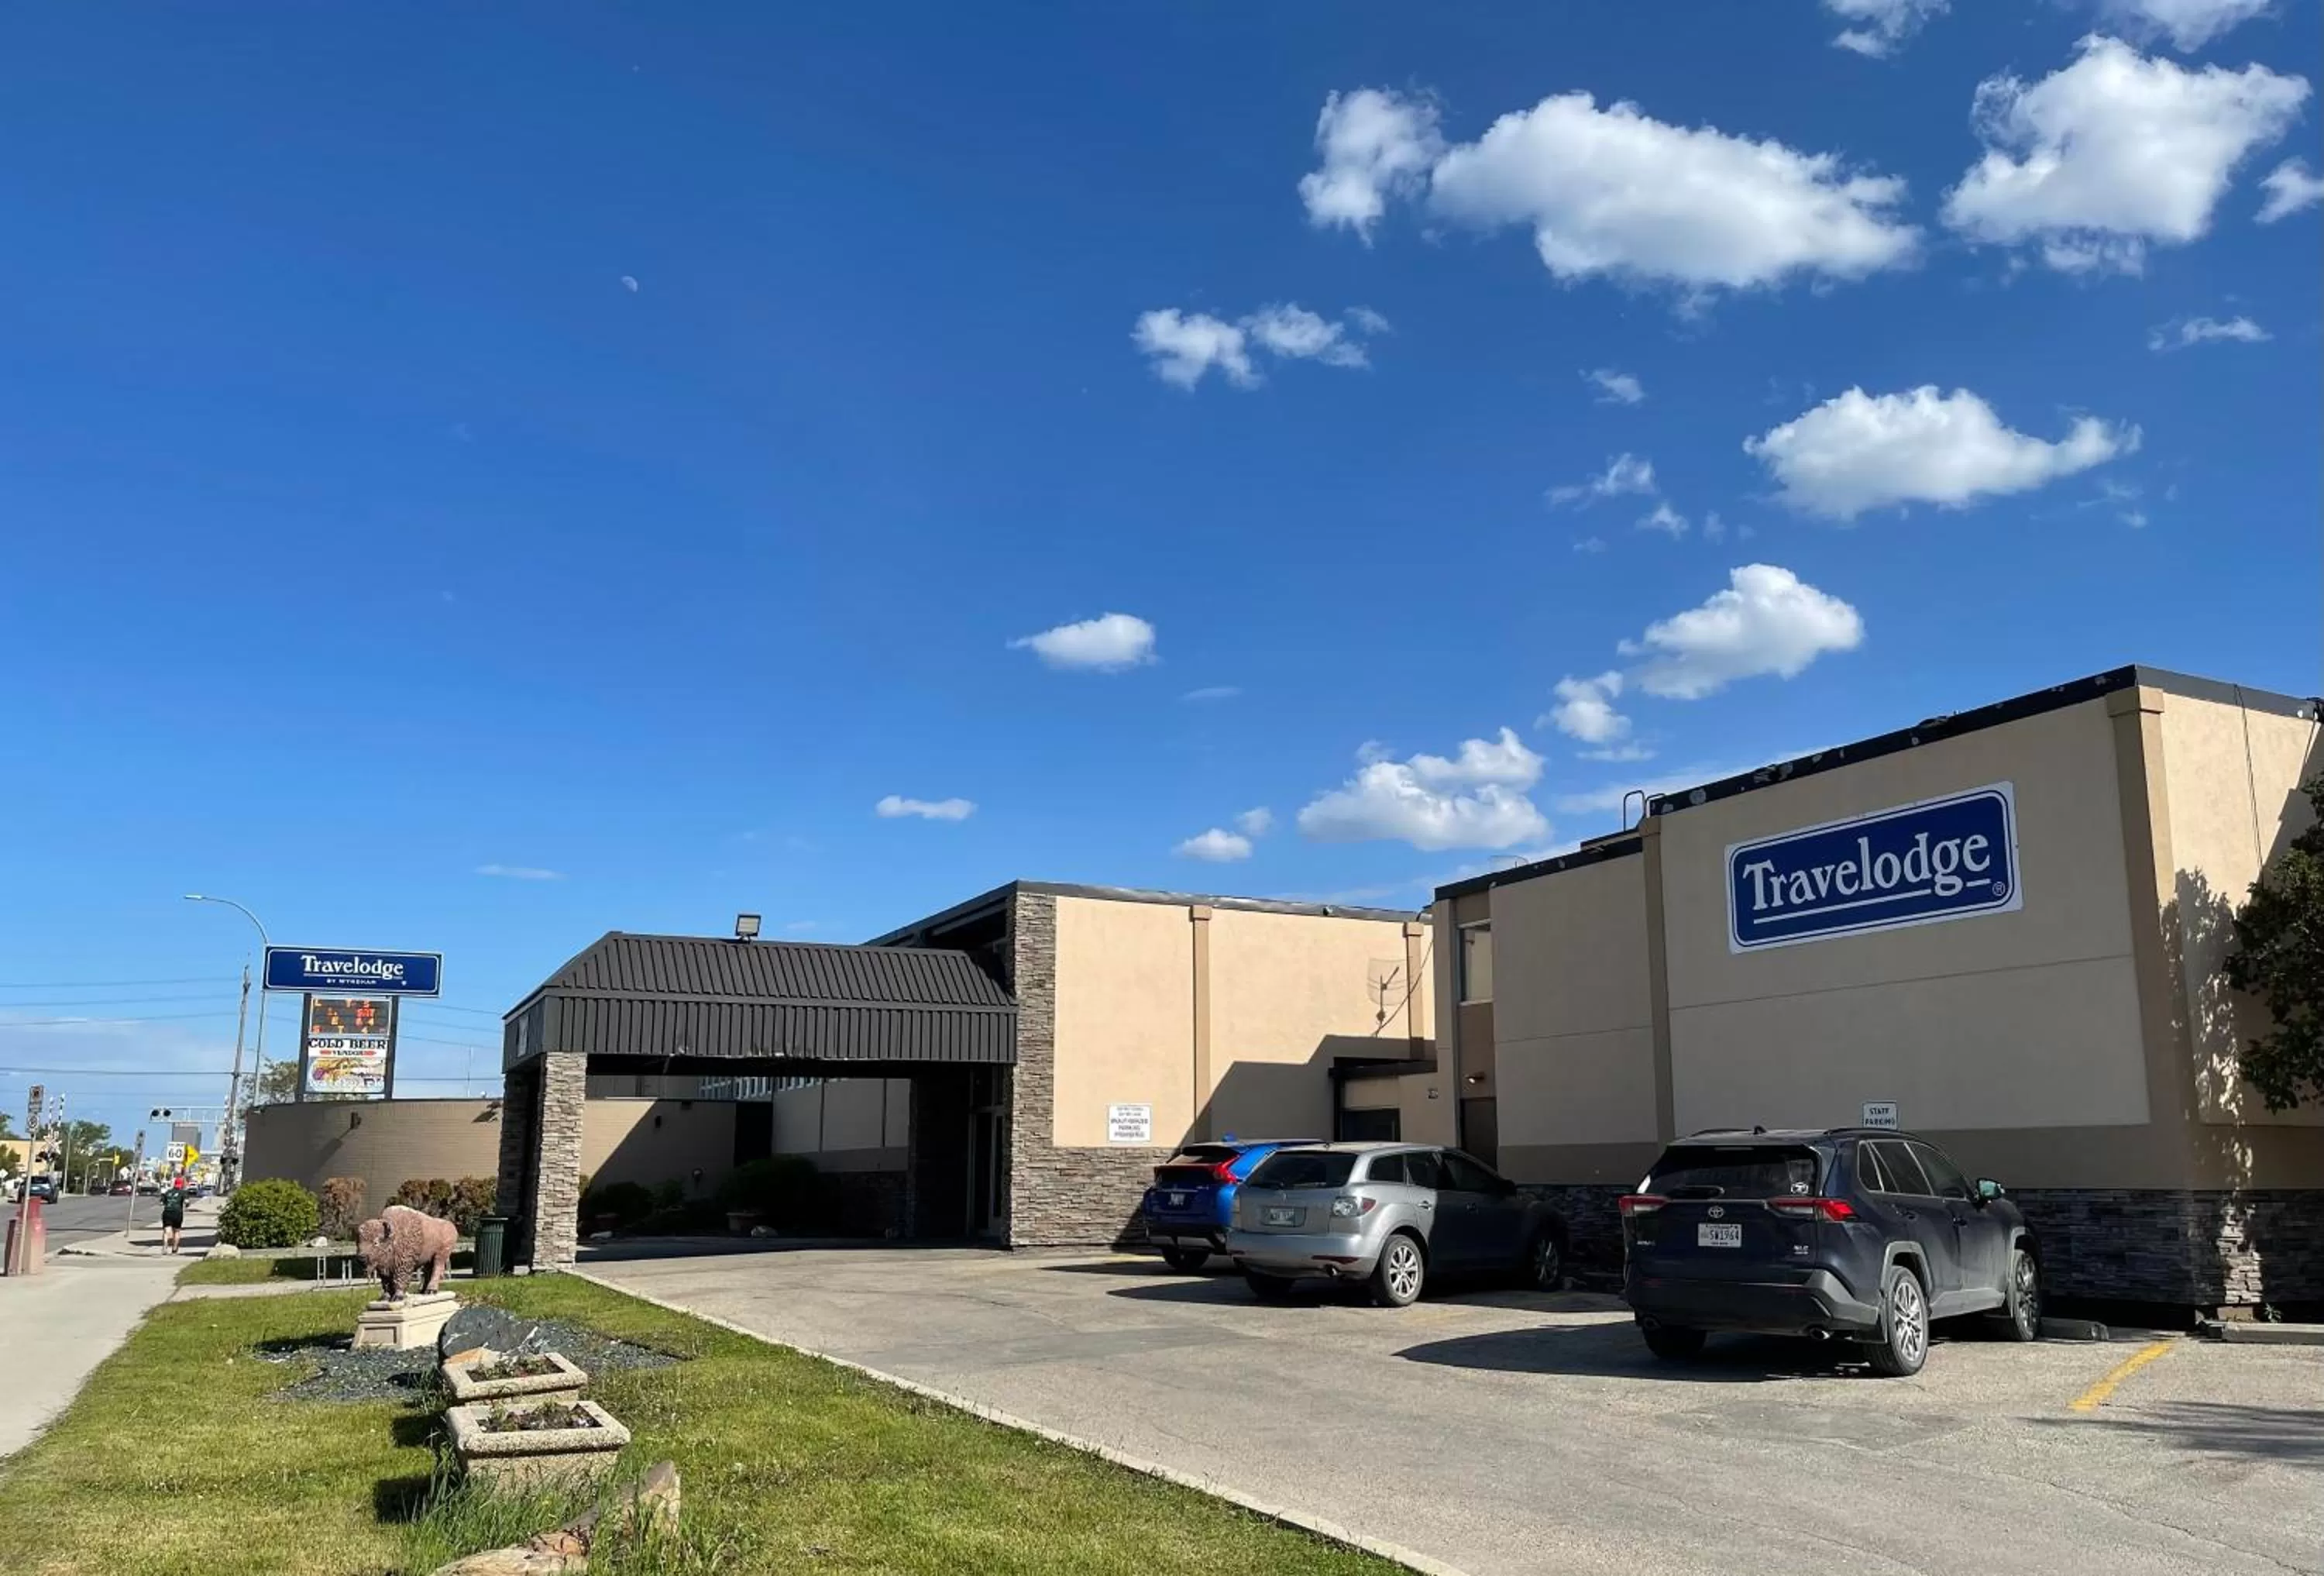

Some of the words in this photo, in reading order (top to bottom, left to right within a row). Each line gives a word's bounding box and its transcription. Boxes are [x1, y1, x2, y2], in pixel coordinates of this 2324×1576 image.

[1742, 831, 1992, 896] Travelodge
[301, 955, 404, 979] Travelodge
[308, 1039, 342, 1048] COLD
[349, 1039, 386, 1050] BEER
[168, 1148, 182, 1158] 60
